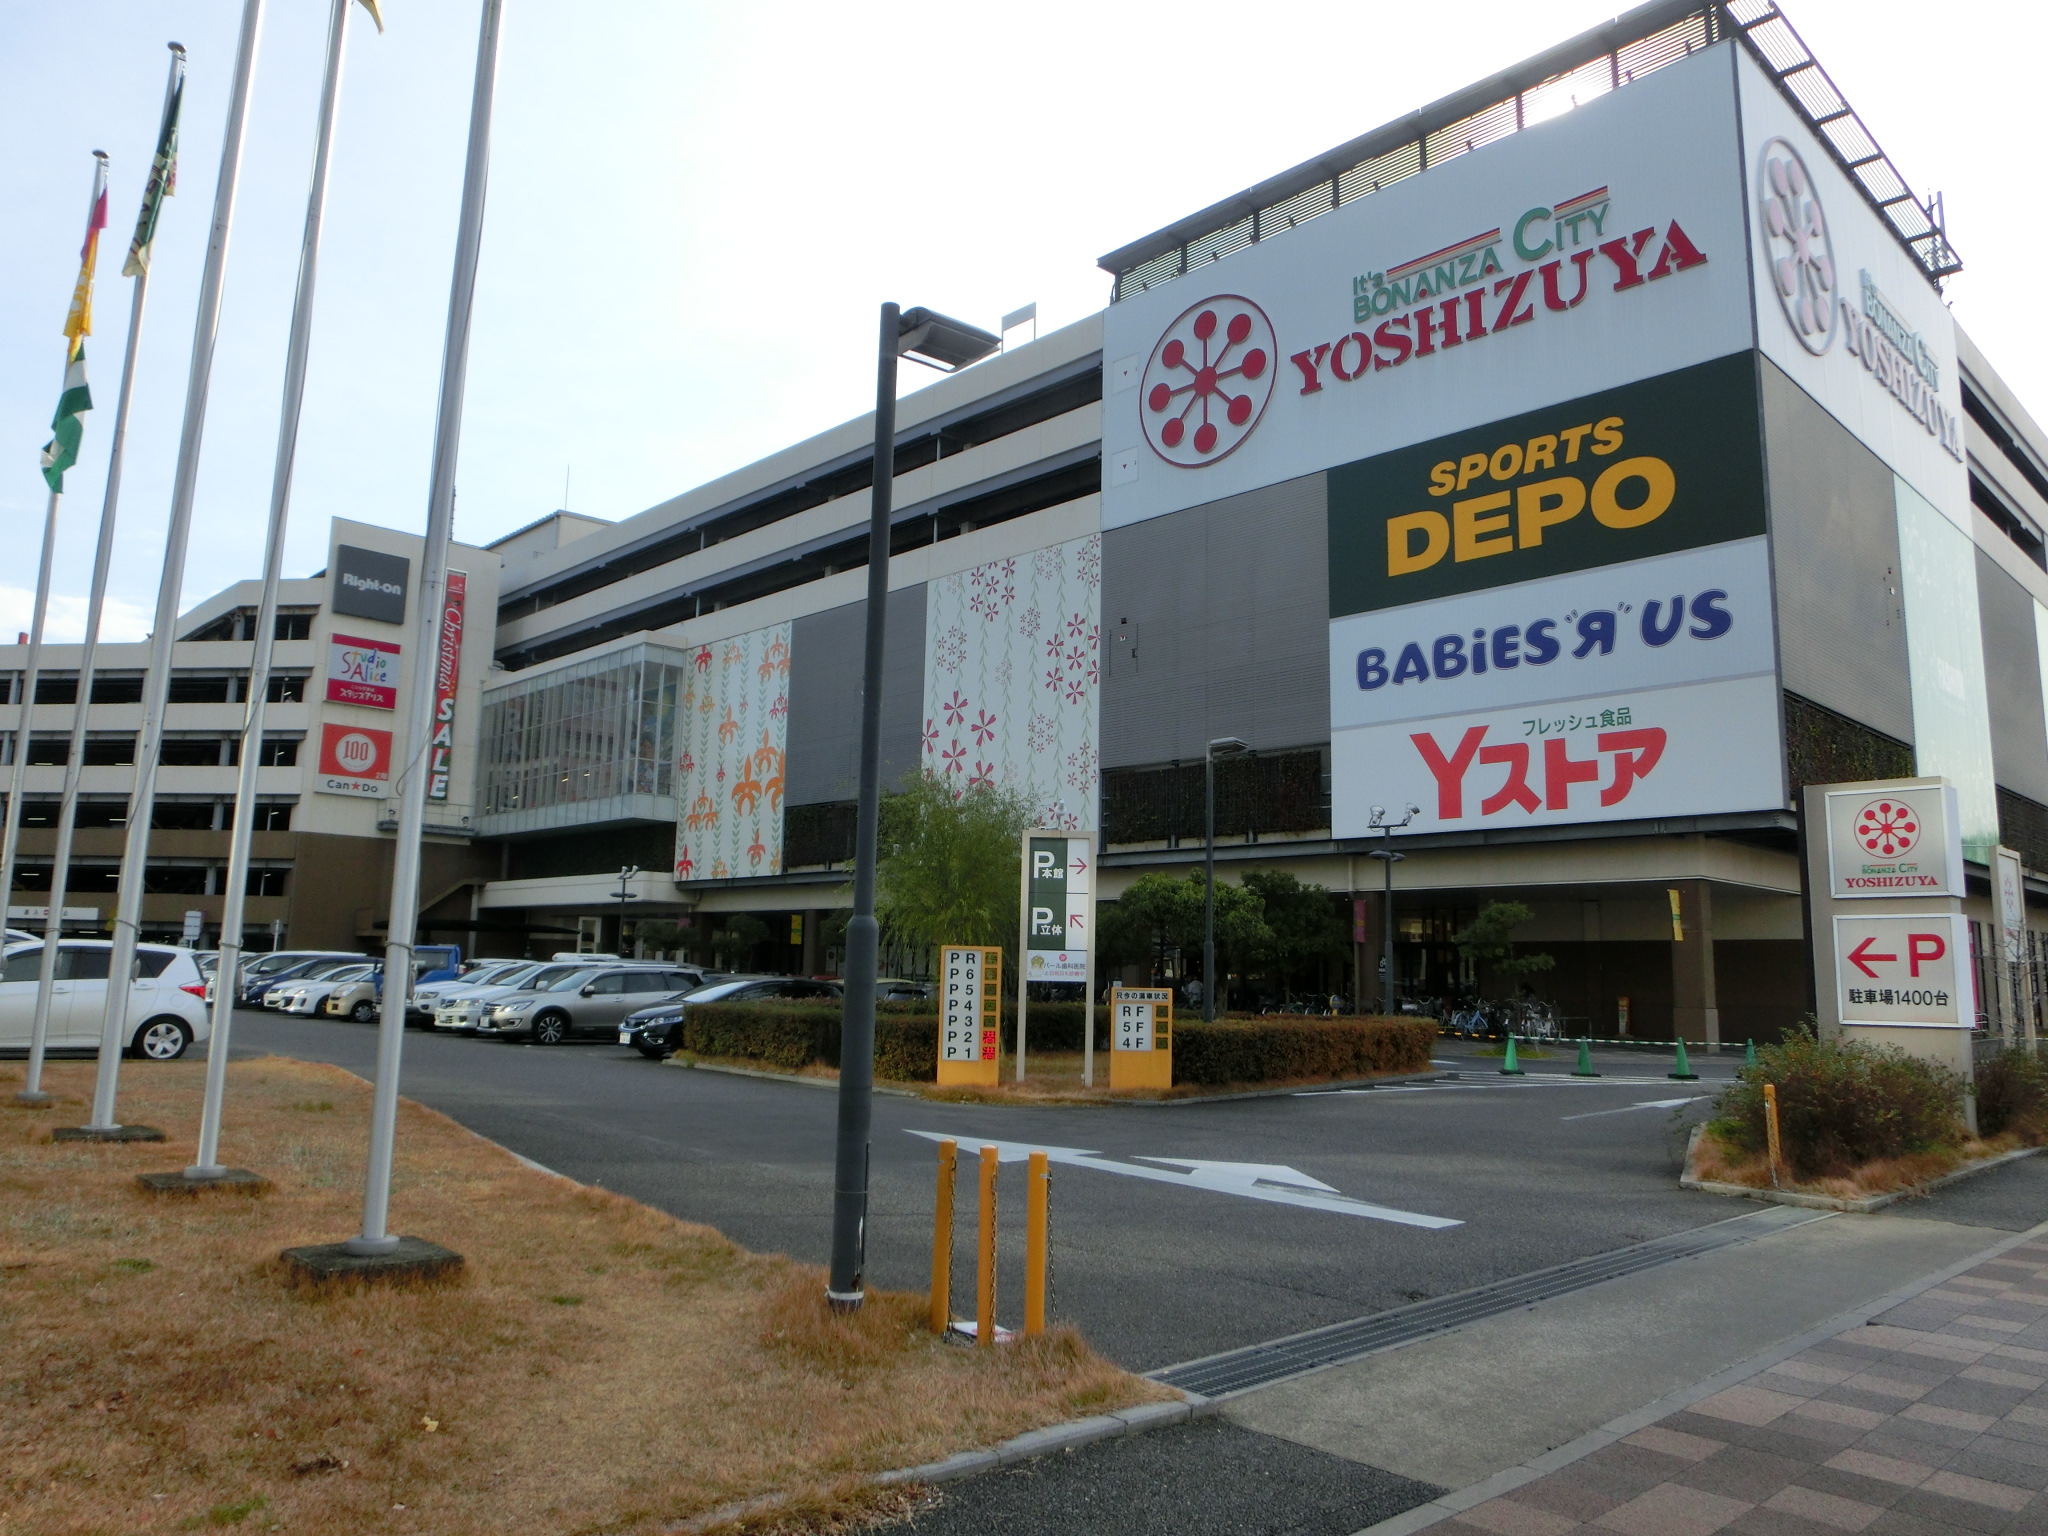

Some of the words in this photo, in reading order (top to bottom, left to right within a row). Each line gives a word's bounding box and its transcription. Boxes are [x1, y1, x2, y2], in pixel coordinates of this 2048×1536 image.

[1353, 270, 1385, 296] It's
[1353, 247, 1503, 324] BONANZA
[1290, 219, 1707, 396] YOSHIZUYA
[1428, 416, 1625, 497] SPORTS
[1386, 456, 1676, 577] DEPO
[341, 647, 387, 674] Studio
[438, 606, 463, 692] Christmas
[349, 662, 387, 682] Alice
[1522, 706, 1632, 736] フレッシュ食品
[343, 740, 369, 761] 100
[431, 698, 455, 797] SALE
[1409, 724, 1668, 820] Yストア
[1034, 851, 1055, 879] P
[1042, 868, 1064, 879] 本館
[1845, 876, 1938, 888] YOSHIZUYA
[1032, 907, 1054, 935] P
[1040, 924, 1063, 936] 立体
[1908, 934, 1946, 978] P
[1848, 988, 1949, 1007] 駐車場1400台
